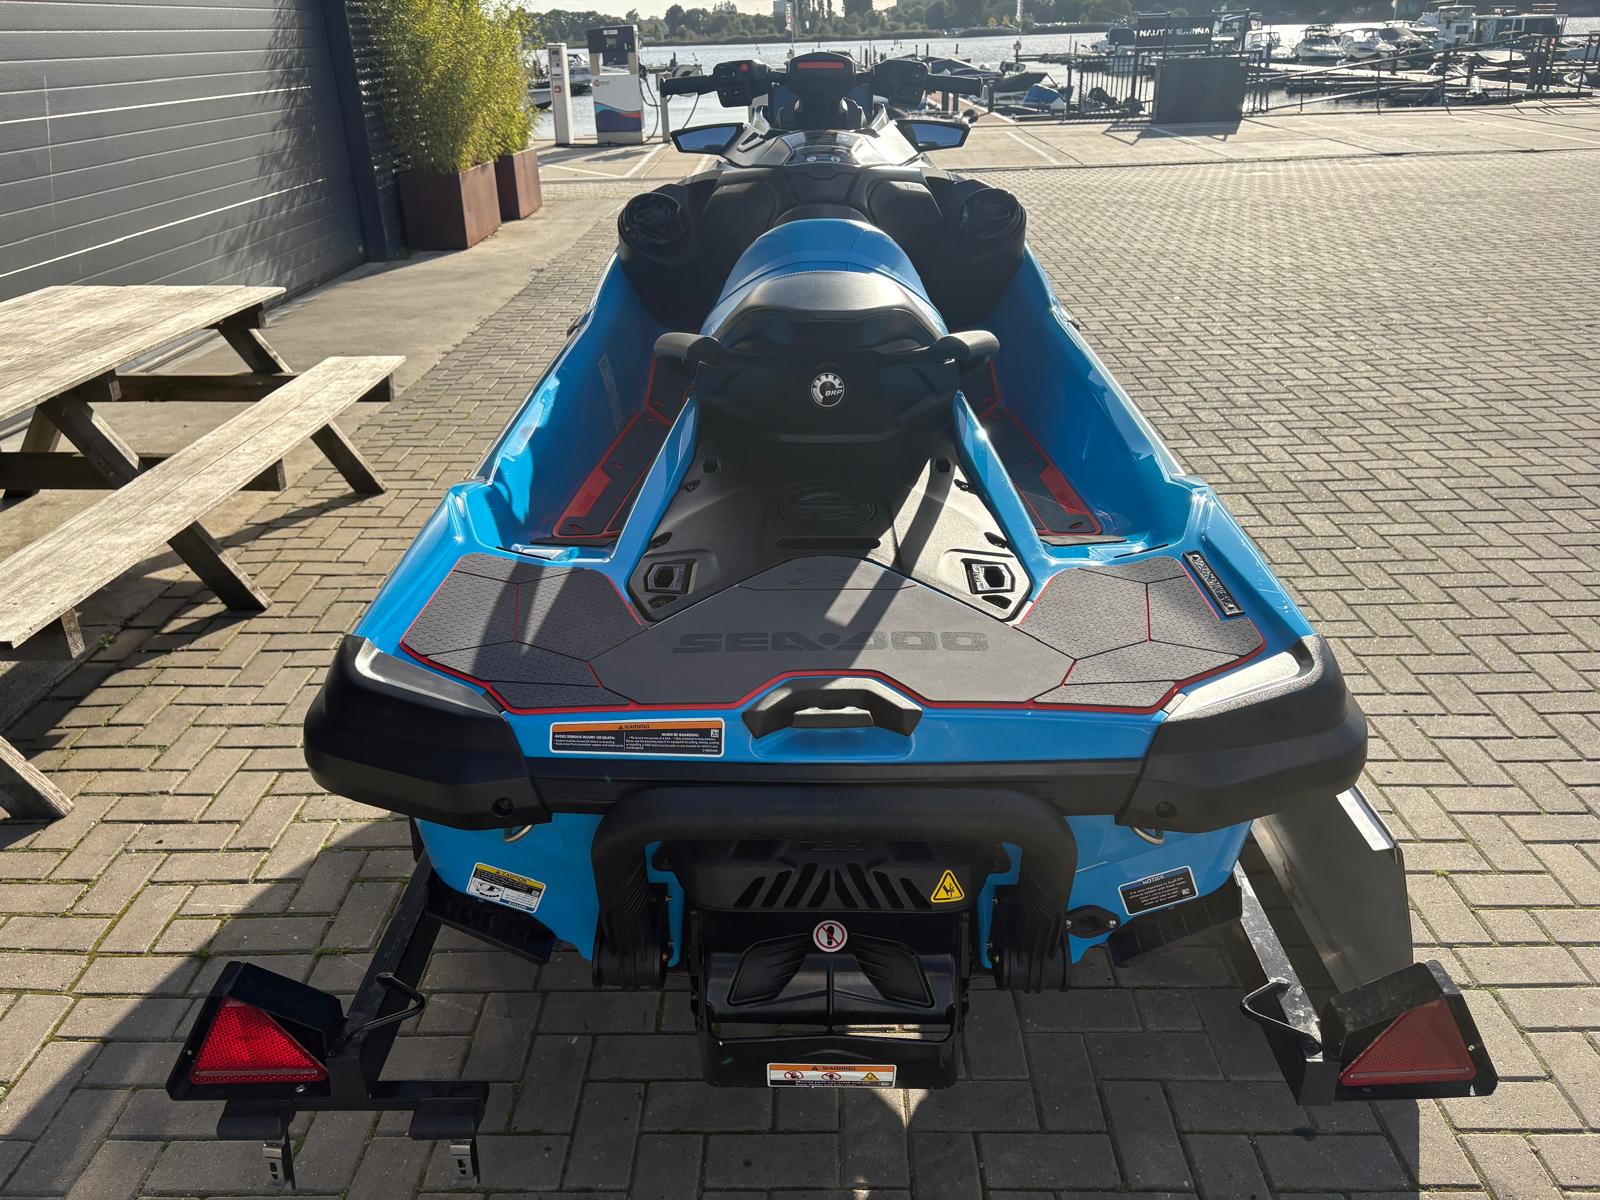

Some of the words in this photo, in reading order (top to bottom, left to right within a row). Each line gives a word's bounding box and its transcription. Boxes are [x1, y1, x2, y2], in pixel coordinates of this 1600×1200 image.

[1139, 28, 1175, 37] NAUTX
[825, 389, 843, 397] BRP
[1142, 874, 1165, 885] NOTICE
